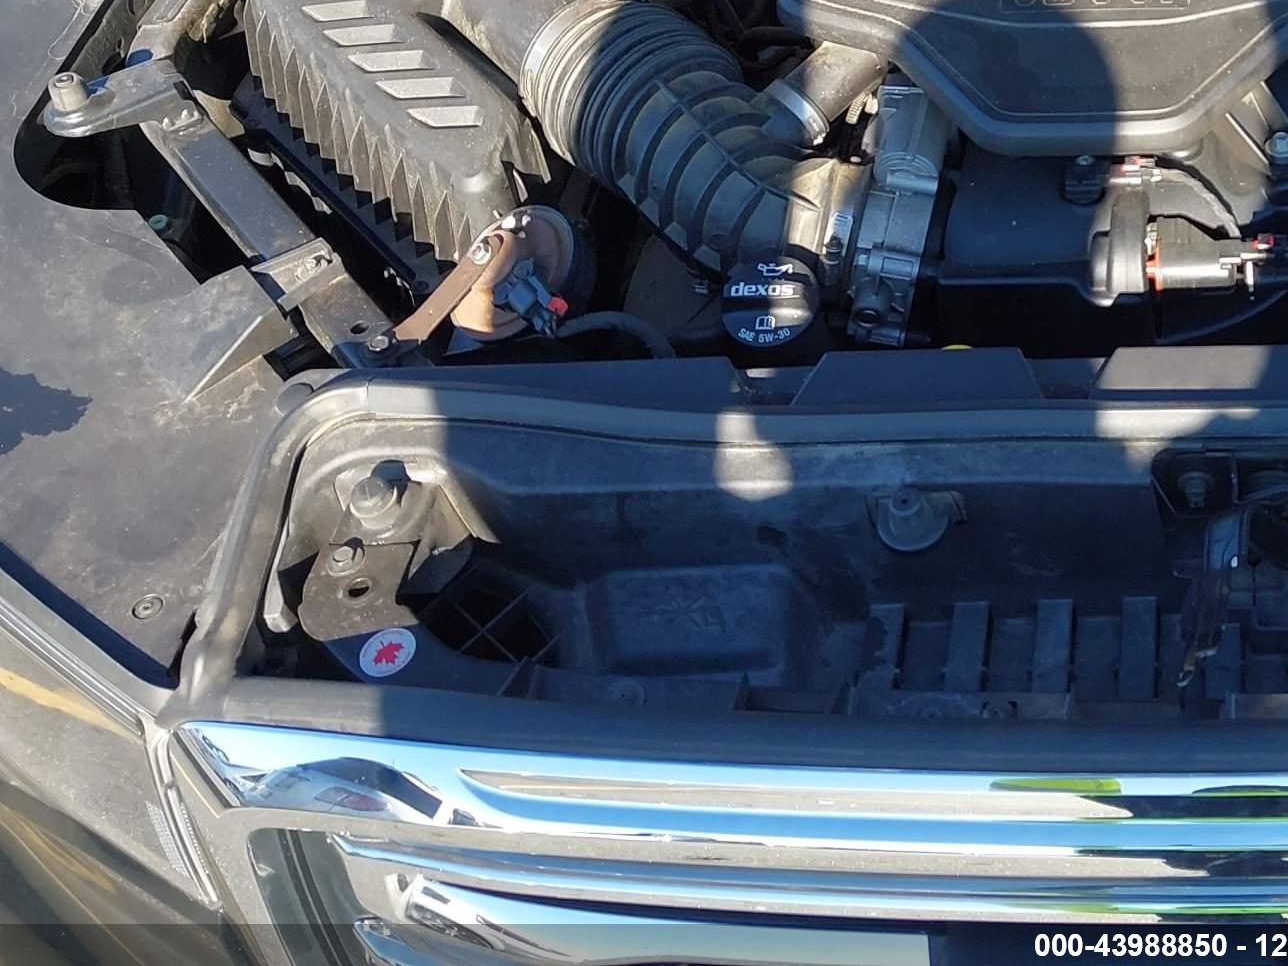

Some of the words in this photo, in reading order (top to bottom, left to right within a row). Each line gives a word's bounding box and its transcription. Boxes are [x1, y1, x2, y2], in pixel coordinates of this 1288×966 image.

[730, 282, 797, 297] dexos
[738, 328, 755, 342] SAE
[758, 327, 791, 343] 5W-30
